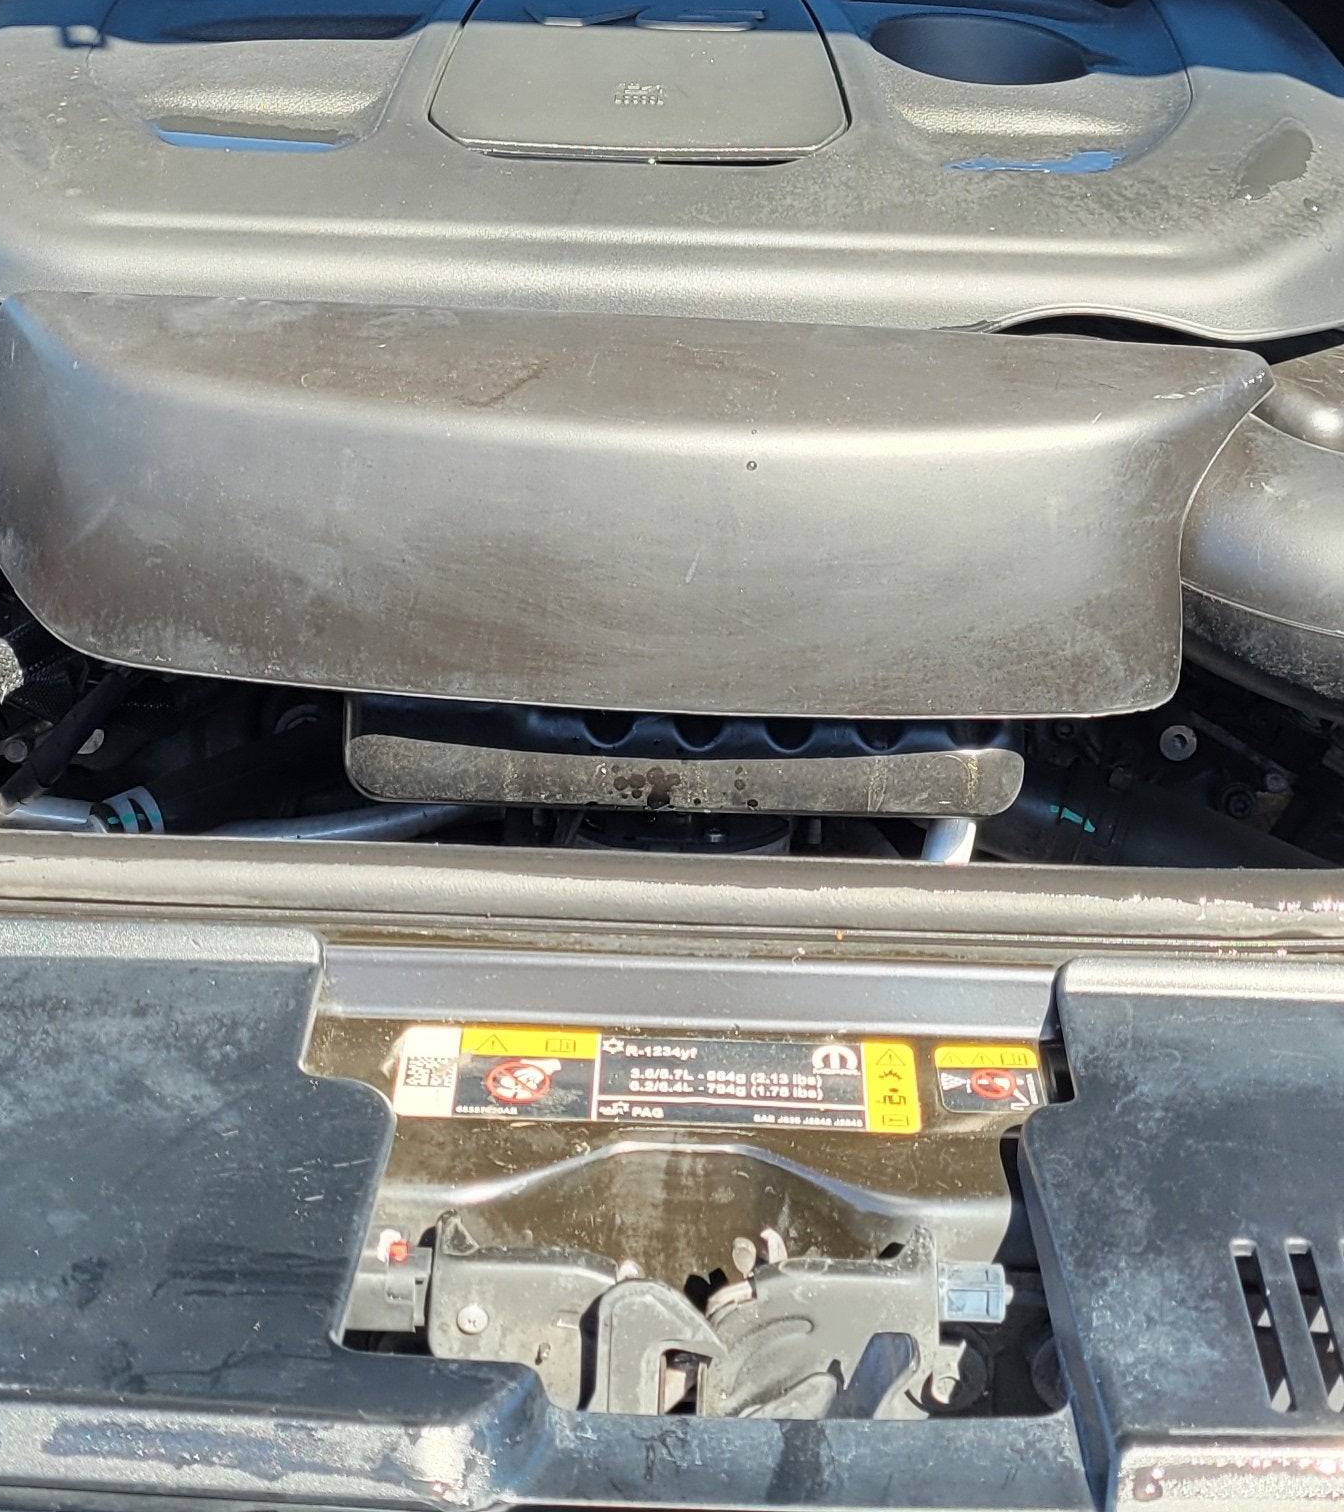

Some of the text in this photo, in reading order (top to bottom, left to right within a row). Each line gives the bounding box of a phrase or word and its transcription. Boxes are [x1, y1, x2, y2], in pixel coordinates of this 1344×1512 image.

[625, 1044, 698, 1061] R-1234yf
[792, 1073, 823, 1089] lbs)
[792, 1085, 824, 1101] lbs)
[631, 1106, 665, 1119] PAG
